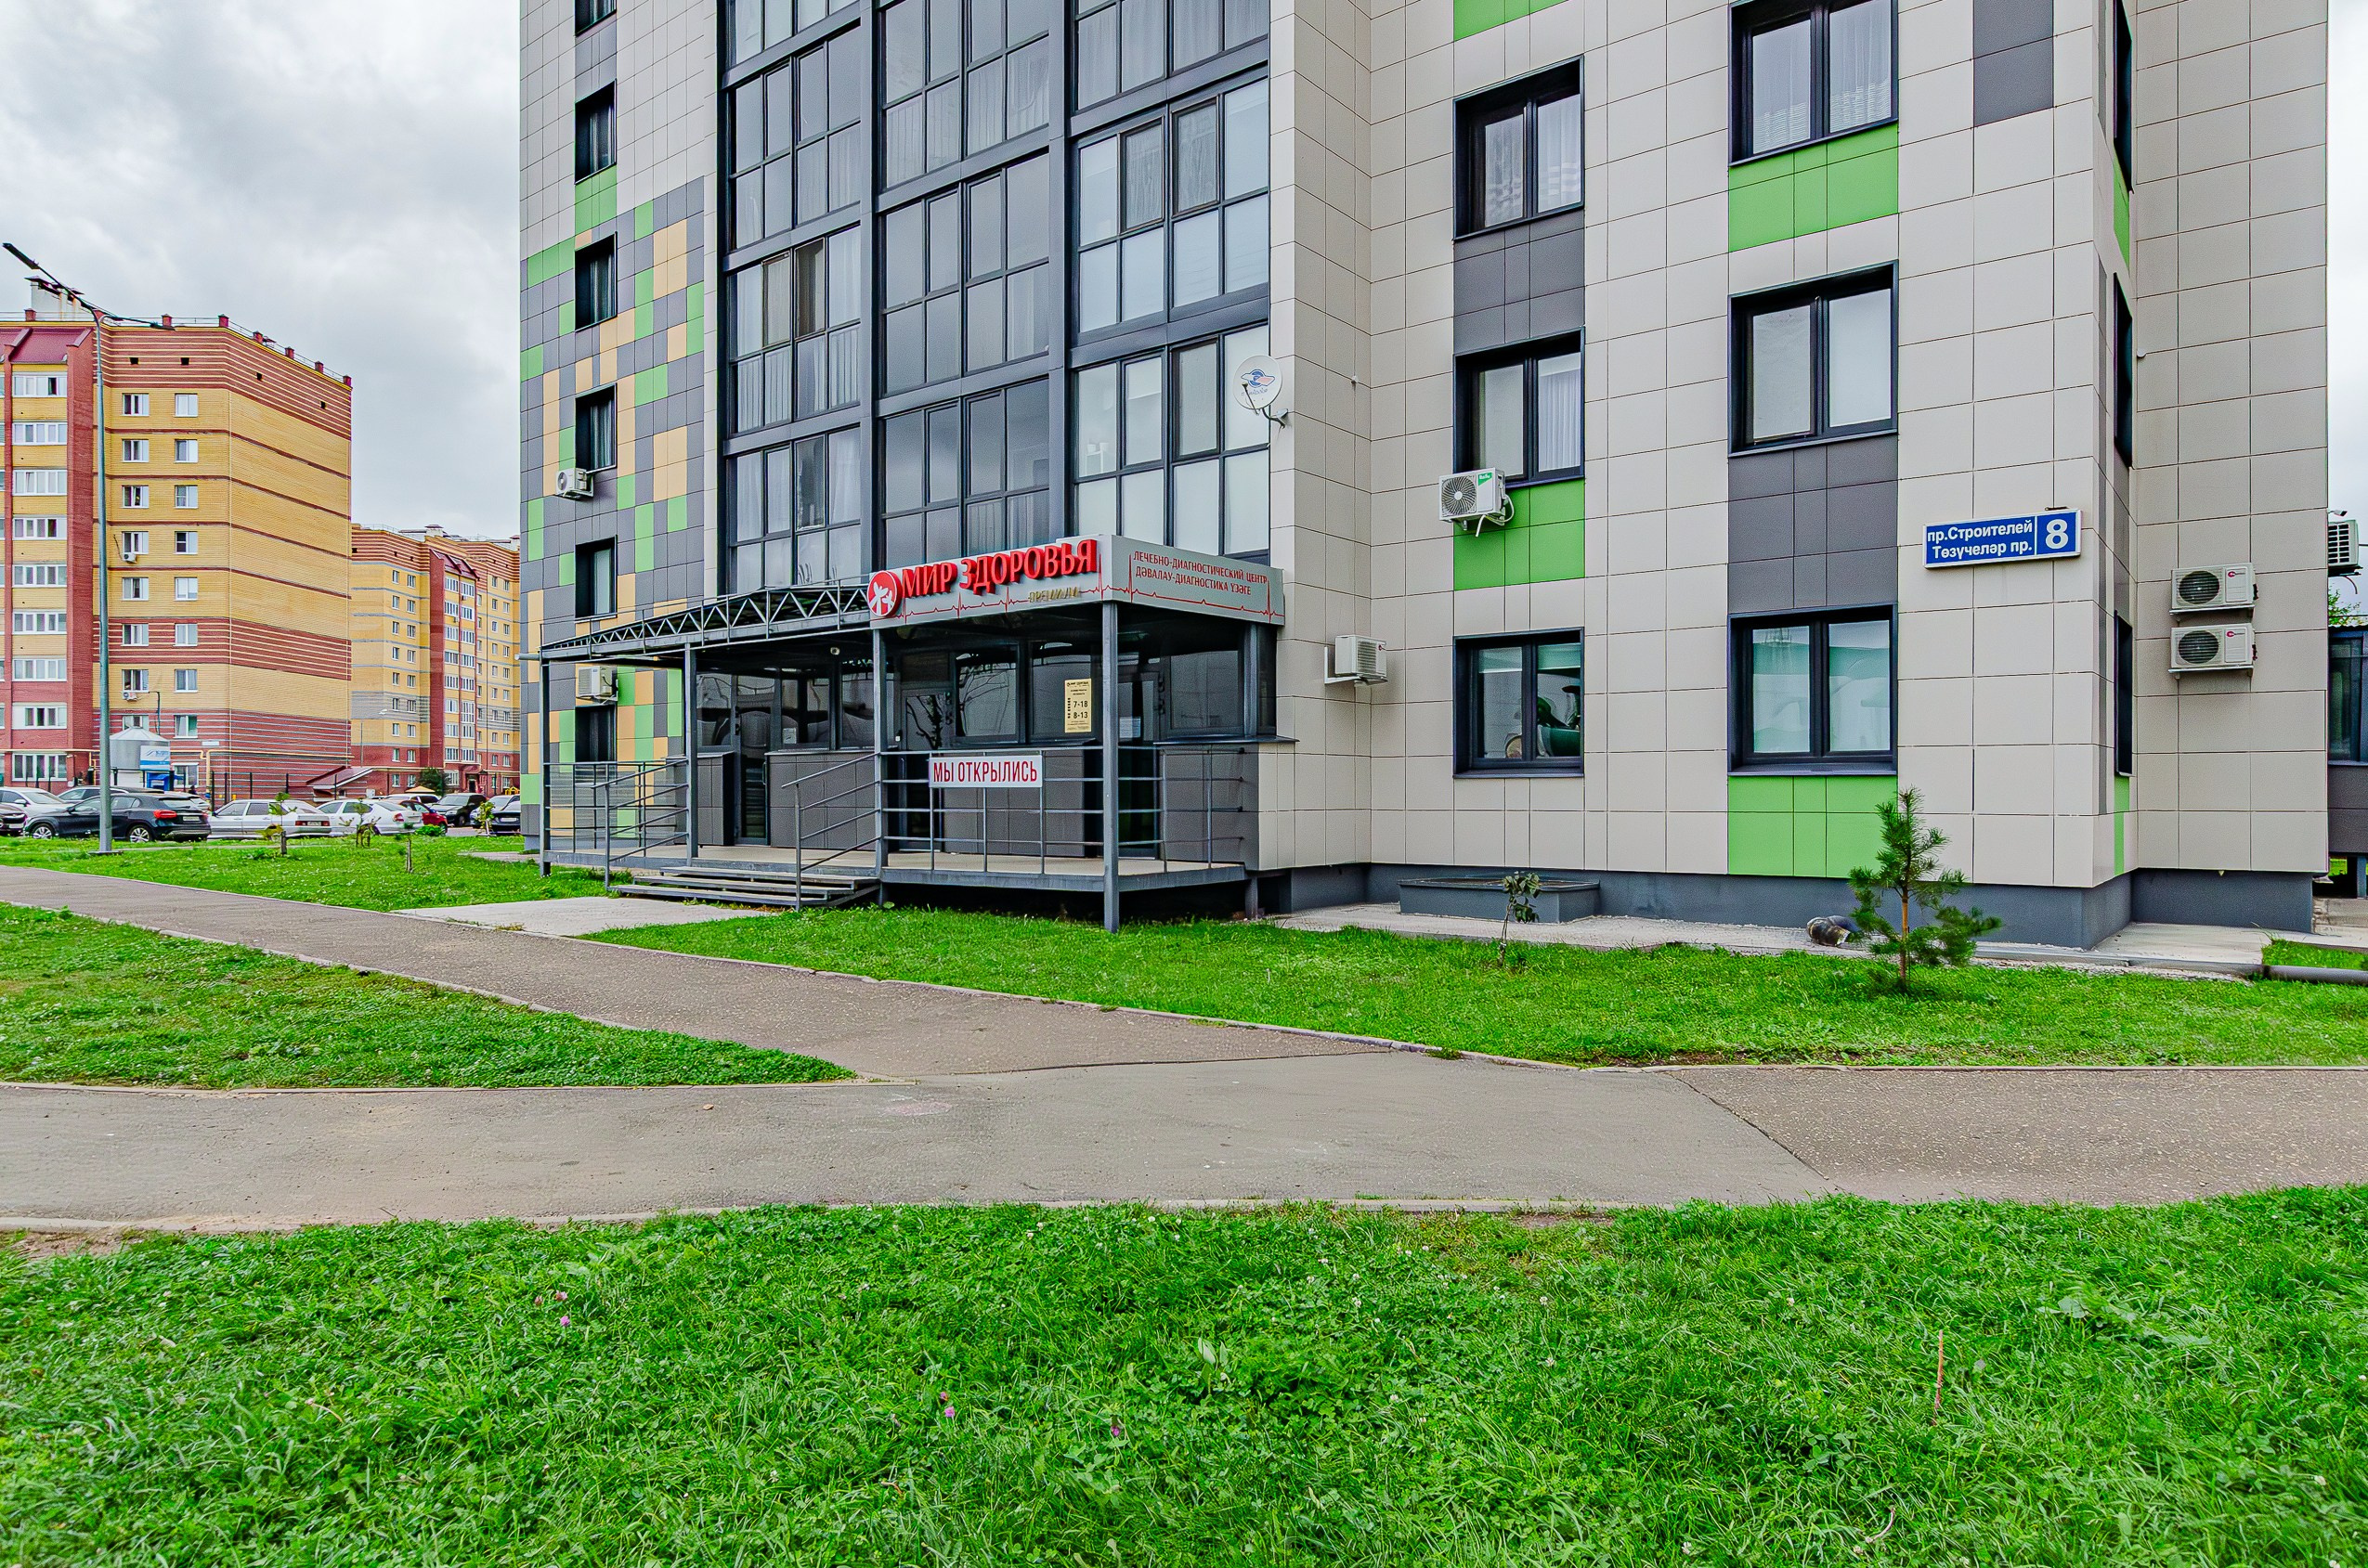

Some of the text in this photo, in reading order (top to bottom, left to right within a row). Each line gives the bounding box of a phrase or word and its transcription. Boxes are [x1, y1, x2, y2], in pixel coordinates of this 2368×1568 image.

[1927, 520, 2033, 544] пр.Строителей
[2045, 518, 2069, 550] 8
[1932, 540, 2033, 560] Төзүчеләр пр.
[902, 538, 1098, 598] МИР ЗДОРОВЬЯ
[1133, 551, 1268, 585] ЛЕЧЕБНО-ДИАГНОСТИЧЕСКИЙ ЦЕНТР
[933, 760, 1037, 783] МЫ ОТКРЫЛИСЬ
